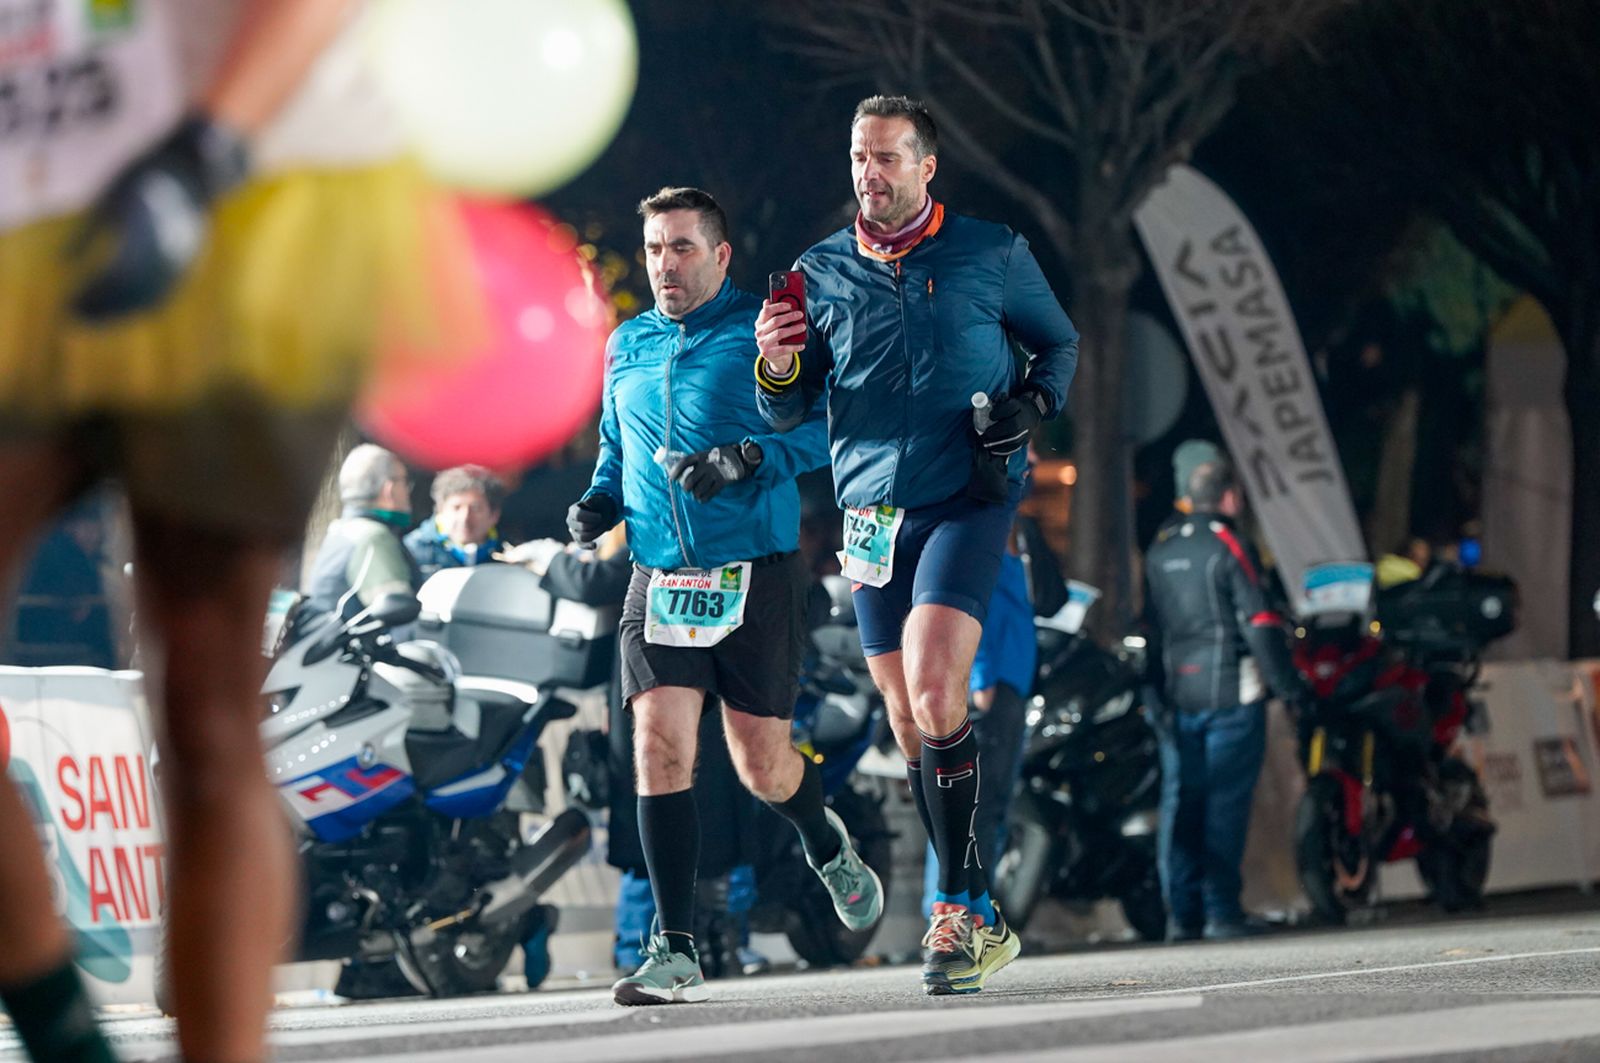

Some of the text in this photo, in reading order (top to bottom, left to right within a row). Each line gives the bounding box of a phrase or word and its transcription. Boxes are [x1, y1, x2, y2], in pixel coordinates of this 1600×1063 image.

[1208, 223, 1335, 484] JAPEMASA
[660, 579, 678, 588] SAN
[668, 589, 725, 618] 7763
[57, 754, 151, 831] SAN
[88, 845, 166, 922] ANT
